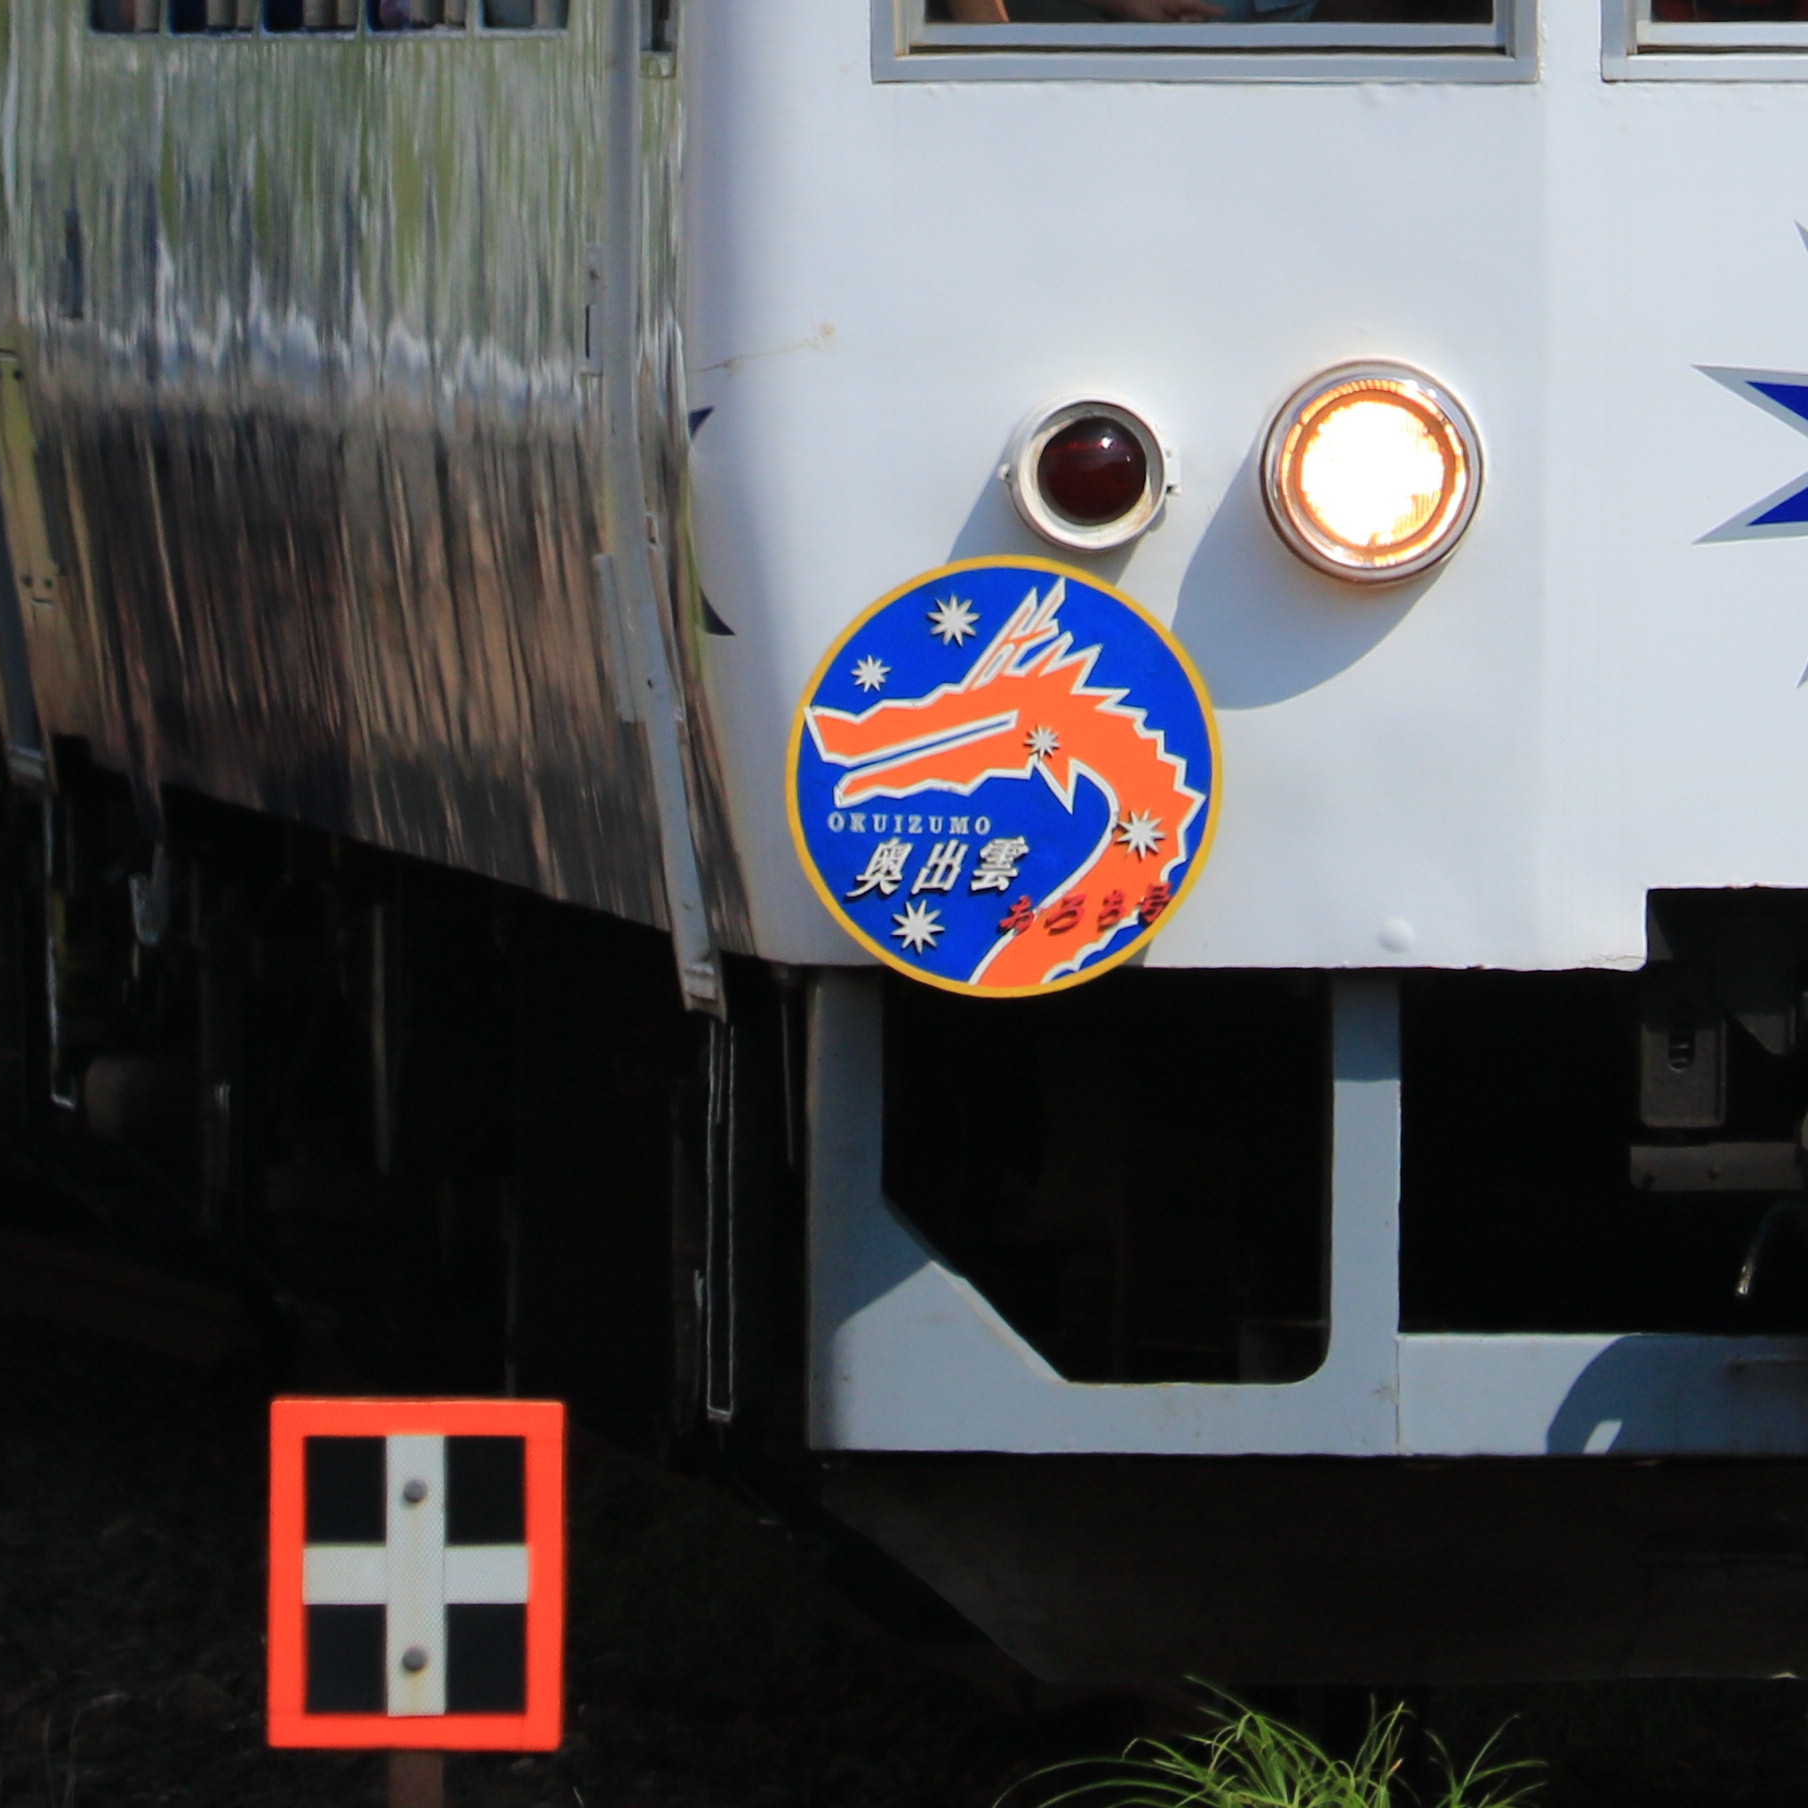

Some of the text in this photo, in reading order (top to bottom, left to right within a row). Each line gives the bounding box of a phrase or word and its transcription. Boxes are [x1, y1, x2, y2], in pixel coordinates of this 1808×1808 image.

[827, 810, 991, 835] OKUIZUMO
[846, 836, 1030, 897] 奥出雲
